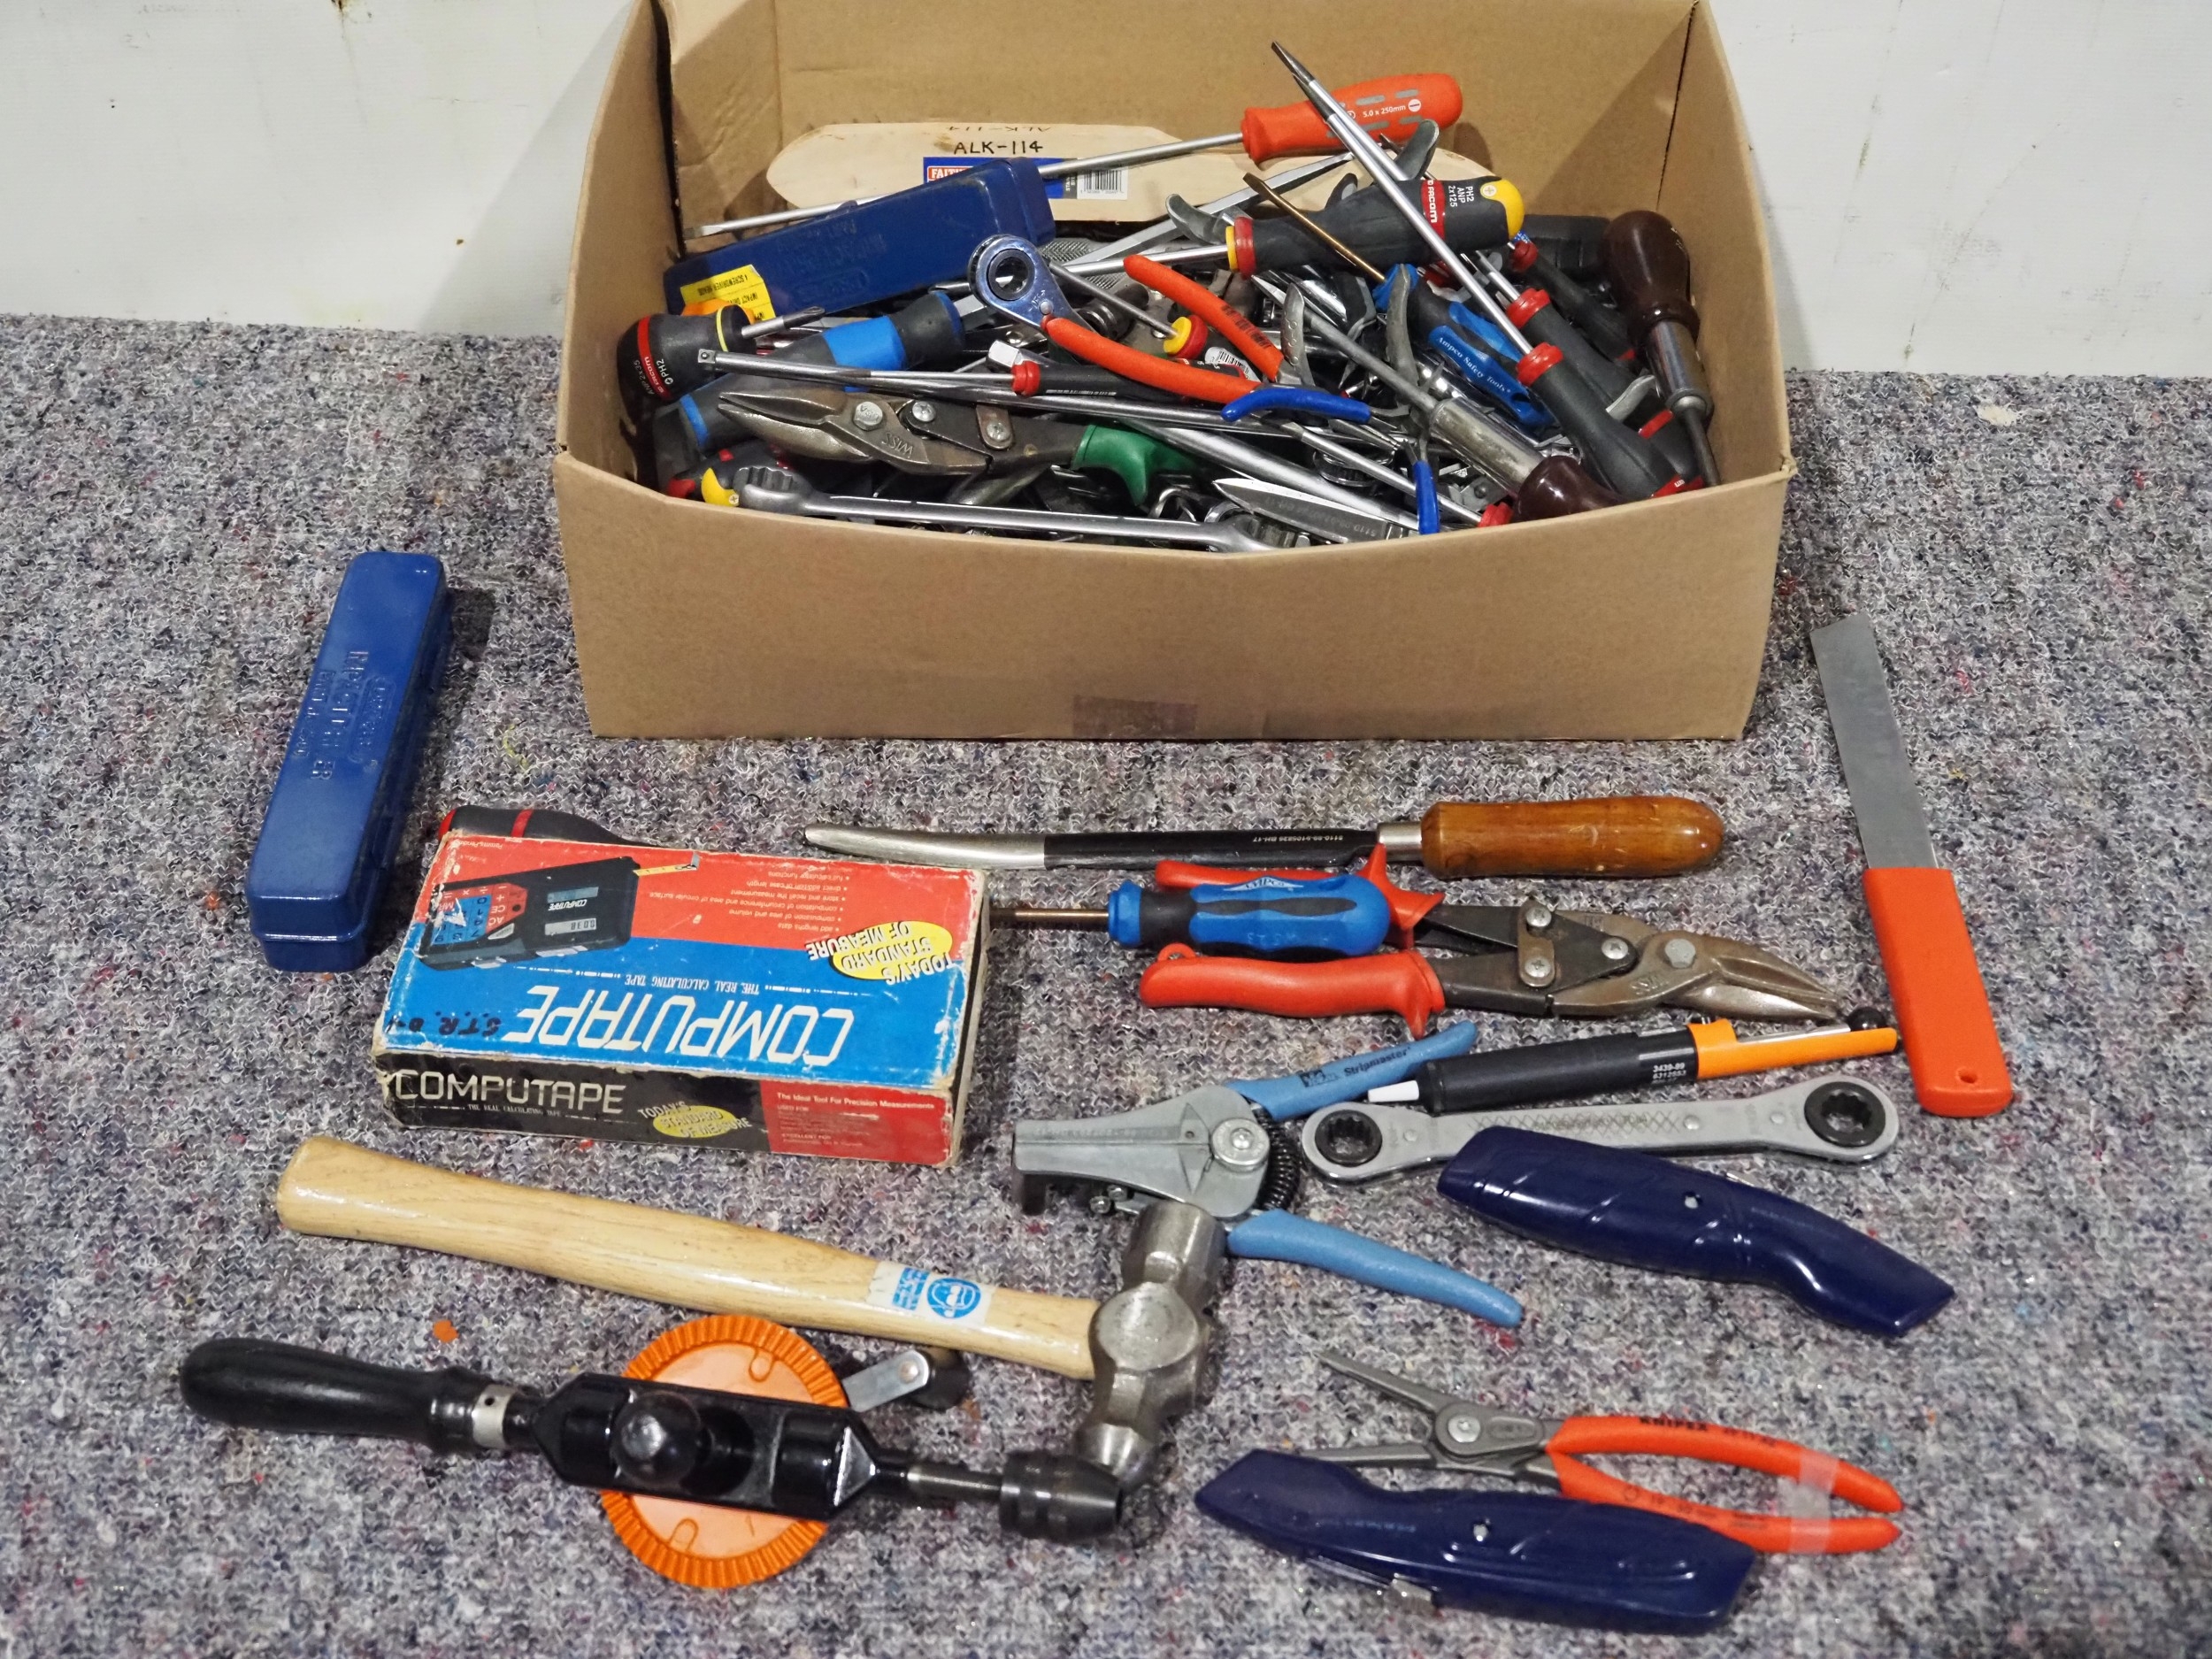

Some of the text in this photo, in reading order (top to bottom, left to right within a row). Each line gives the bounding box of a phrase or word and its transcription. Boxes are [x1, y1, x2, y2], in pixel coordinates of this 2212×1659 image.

[1381, 105, 1406, 115] 250mm
[953, 140, 1043, 155] ALK-114
[1457, 187, 1466, 204] ANP
[1465, 186, 1475, 203] PH2
[1437, 337, 1463, 358] Ampco
[657, 358, 670, 379] PH2
[491, 904, 506, 913] CE
[548, 898, 588, 912] COMPUTAPE
[795, 902, 837, 912] computation
[488, 916, 504, 926] AC
[804, 921, 910, 960] OF MEASURE
[841, 937, 933, 972] STANDARD
[881, 953, 953, 986] TODAY'S
[624, 973, 760, 995] THE REAL CALCULATING TAPE
[499, 984, 855, 1066] COMPUTAPE
[1344, 1048, 1408, 1077] Stripmaster
[395, 1069, 626, 1114] COMPUTAPE
[637, 1100, 689, 1119] TODAY'S
[777, 1092, 791, 1101] The
[793, 1094, 812, 1102] Ideal
[843, 1097, 878, 1107] Precision
[879, 1100, 935, 1110] Measurements
[660, 1110, 724, 1128] STANDARD
[699, 1117, 752, 1135] MEASURE
